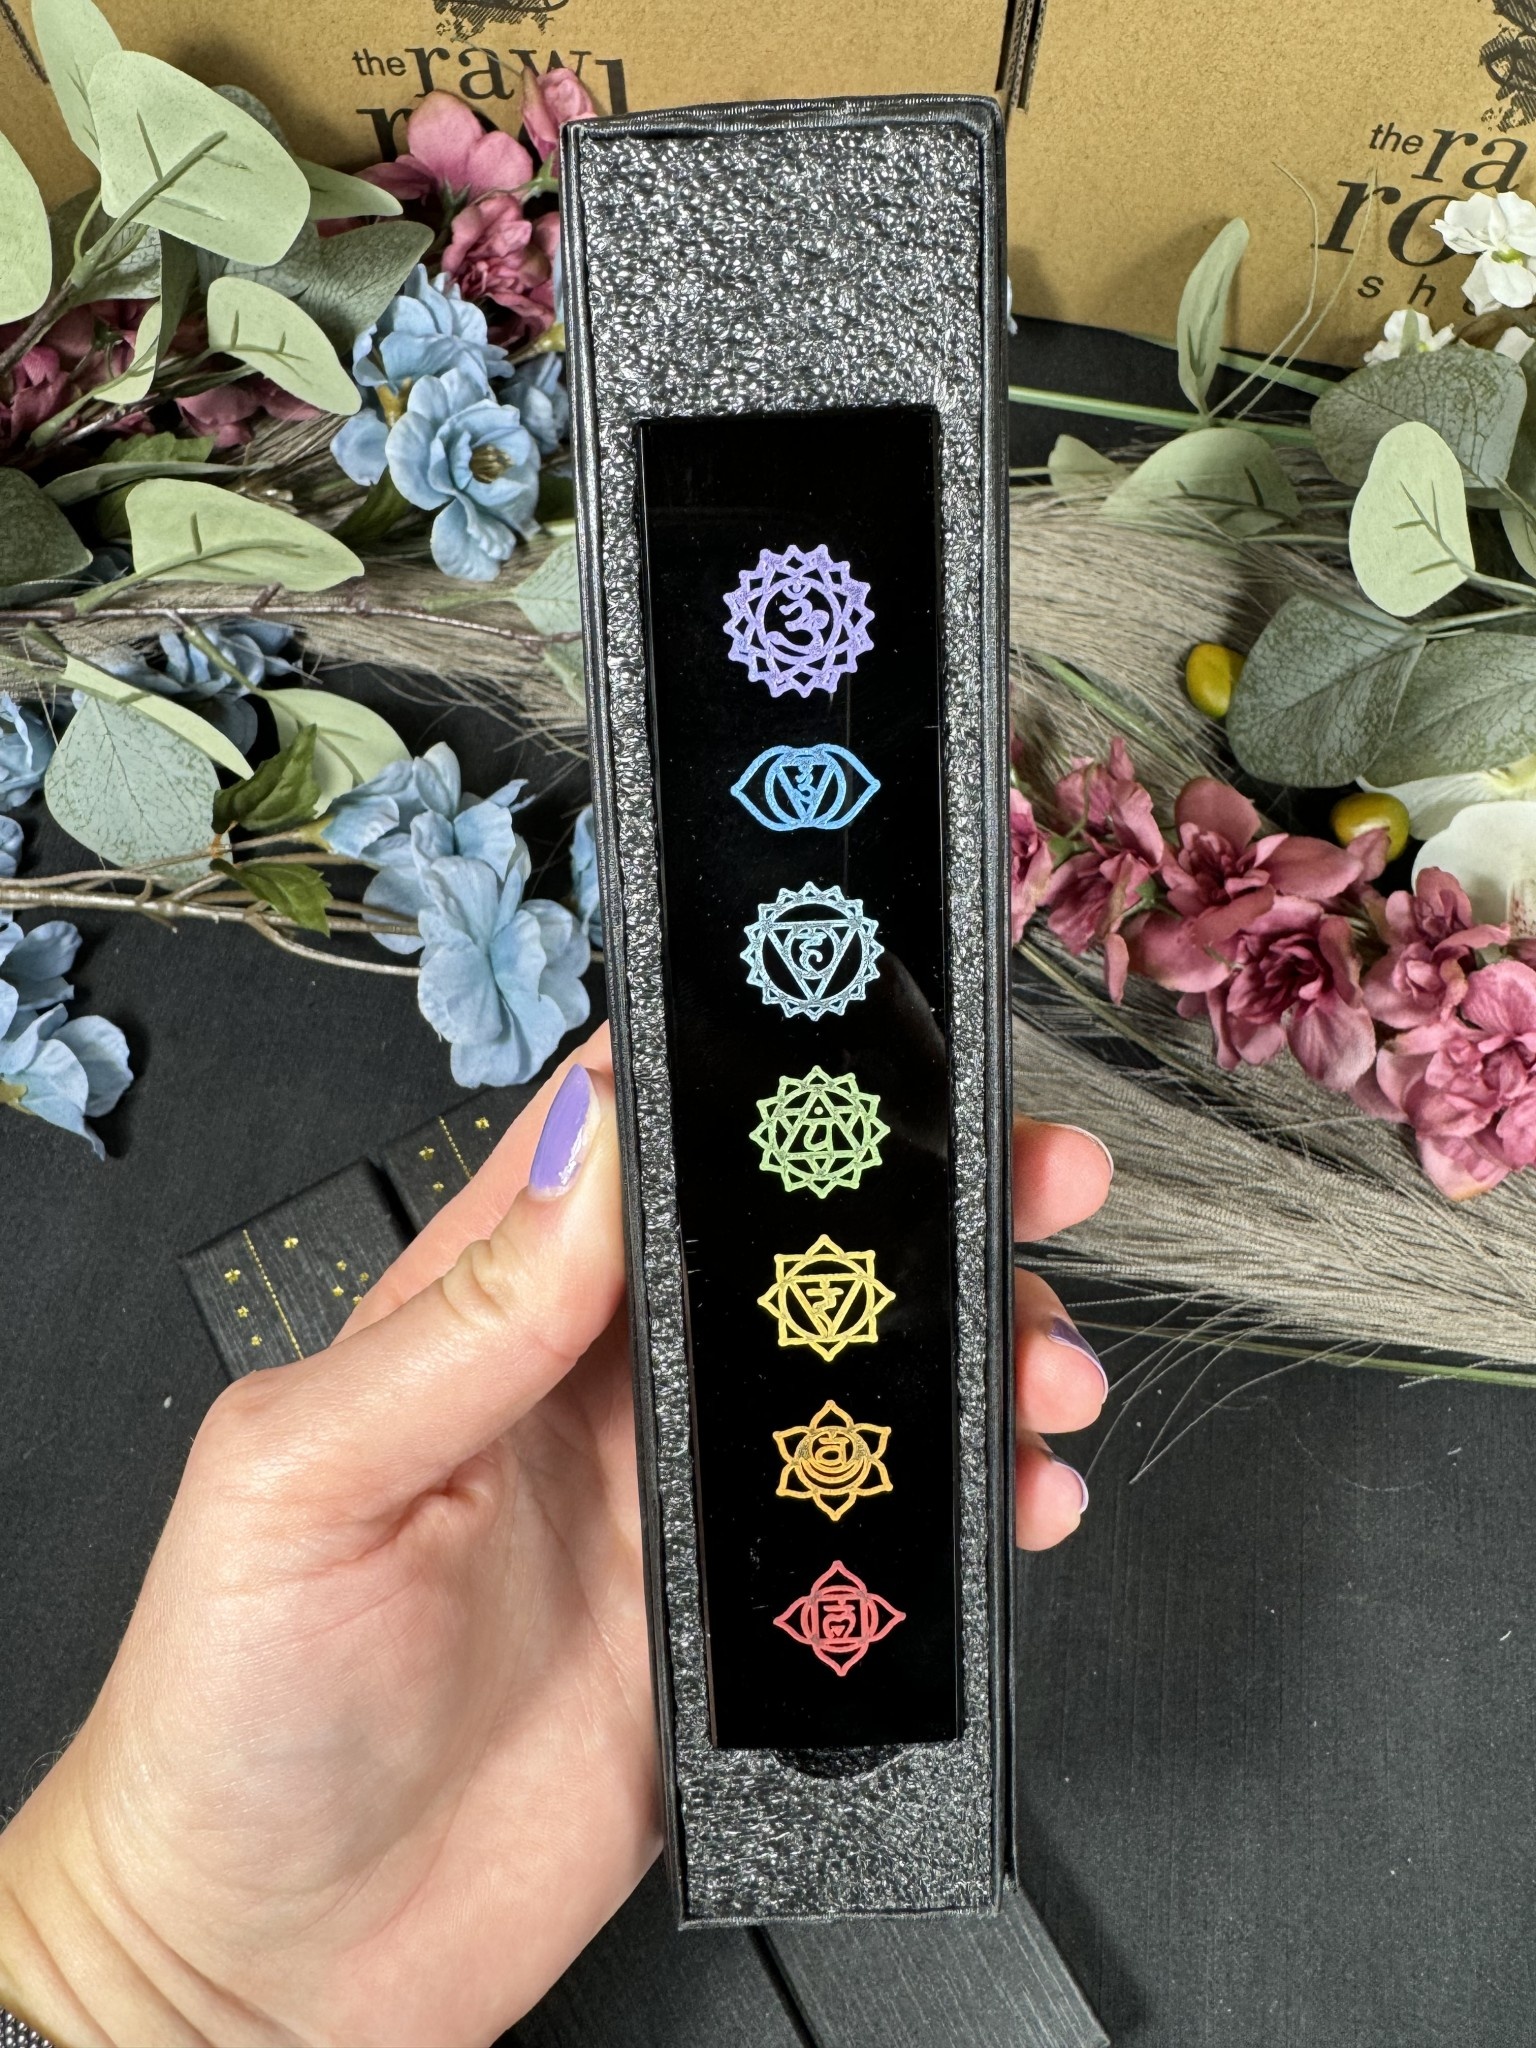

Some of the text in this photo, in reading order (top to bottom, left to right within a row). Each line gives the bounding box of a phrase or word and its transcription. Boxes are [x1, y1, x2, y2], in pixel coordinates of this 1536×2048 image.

[352, 48, 406, 76] the
[1369, 122, 1424, 155] the
[1311, 180, 1487, 267] ro
